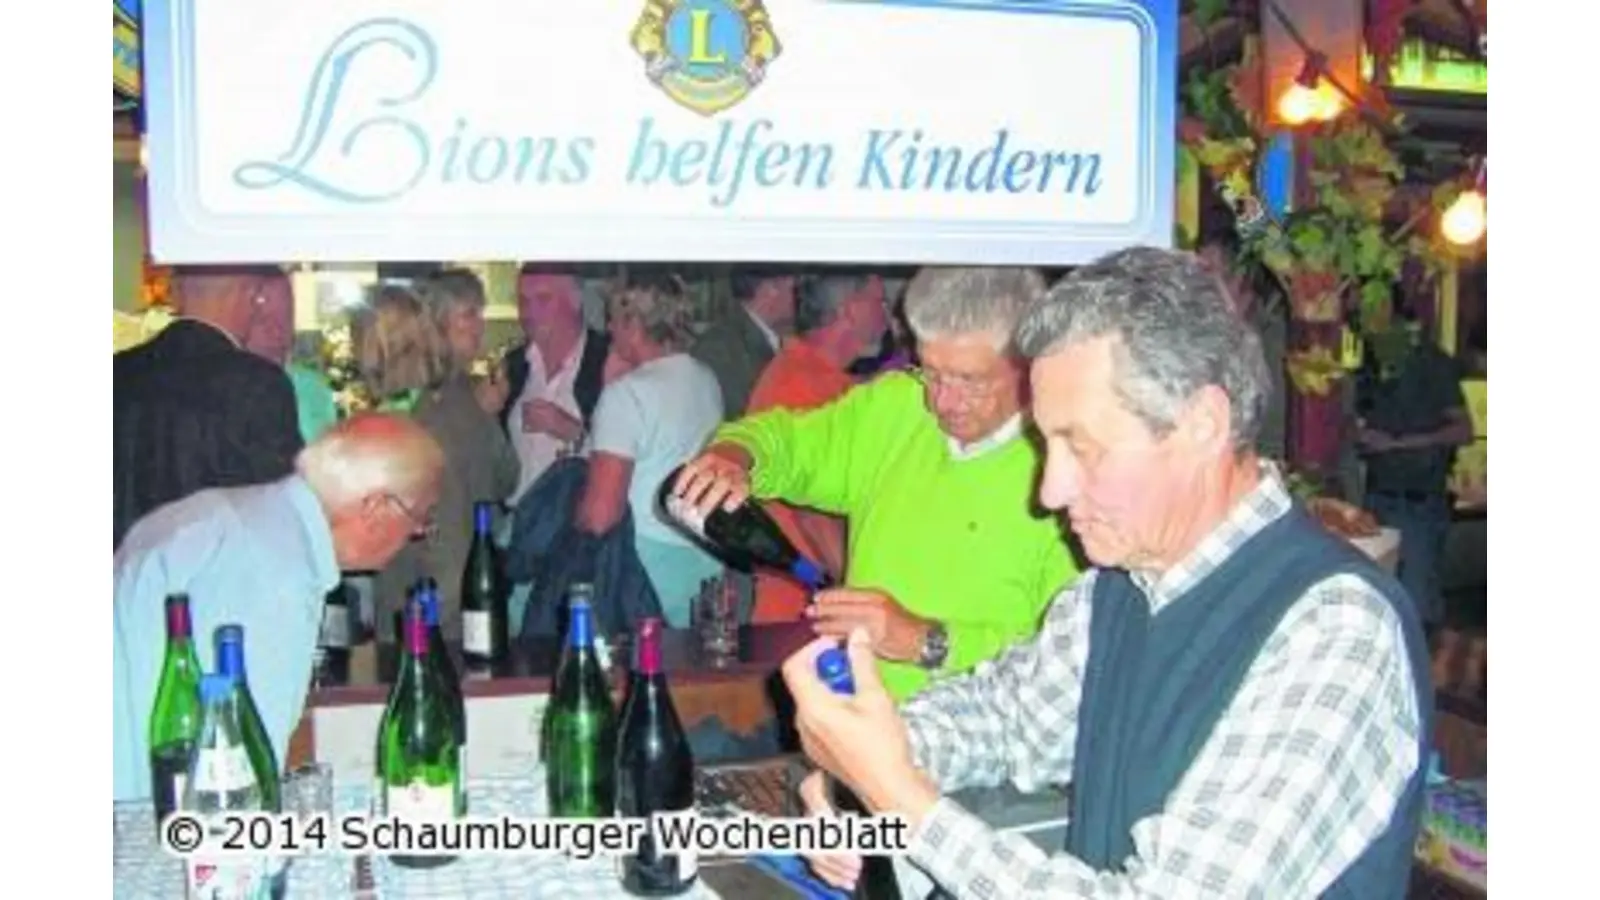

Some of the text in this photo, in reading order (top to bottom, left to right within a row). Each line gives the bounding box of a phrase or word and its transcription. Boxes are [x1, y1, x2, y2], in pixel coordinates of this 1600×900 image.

[688, 10, 725, 64] L
[233, 17, 596, 203] Lions
[625, 117, 834, 207] helfen
[858, 129, 1104, 197] Kindern
